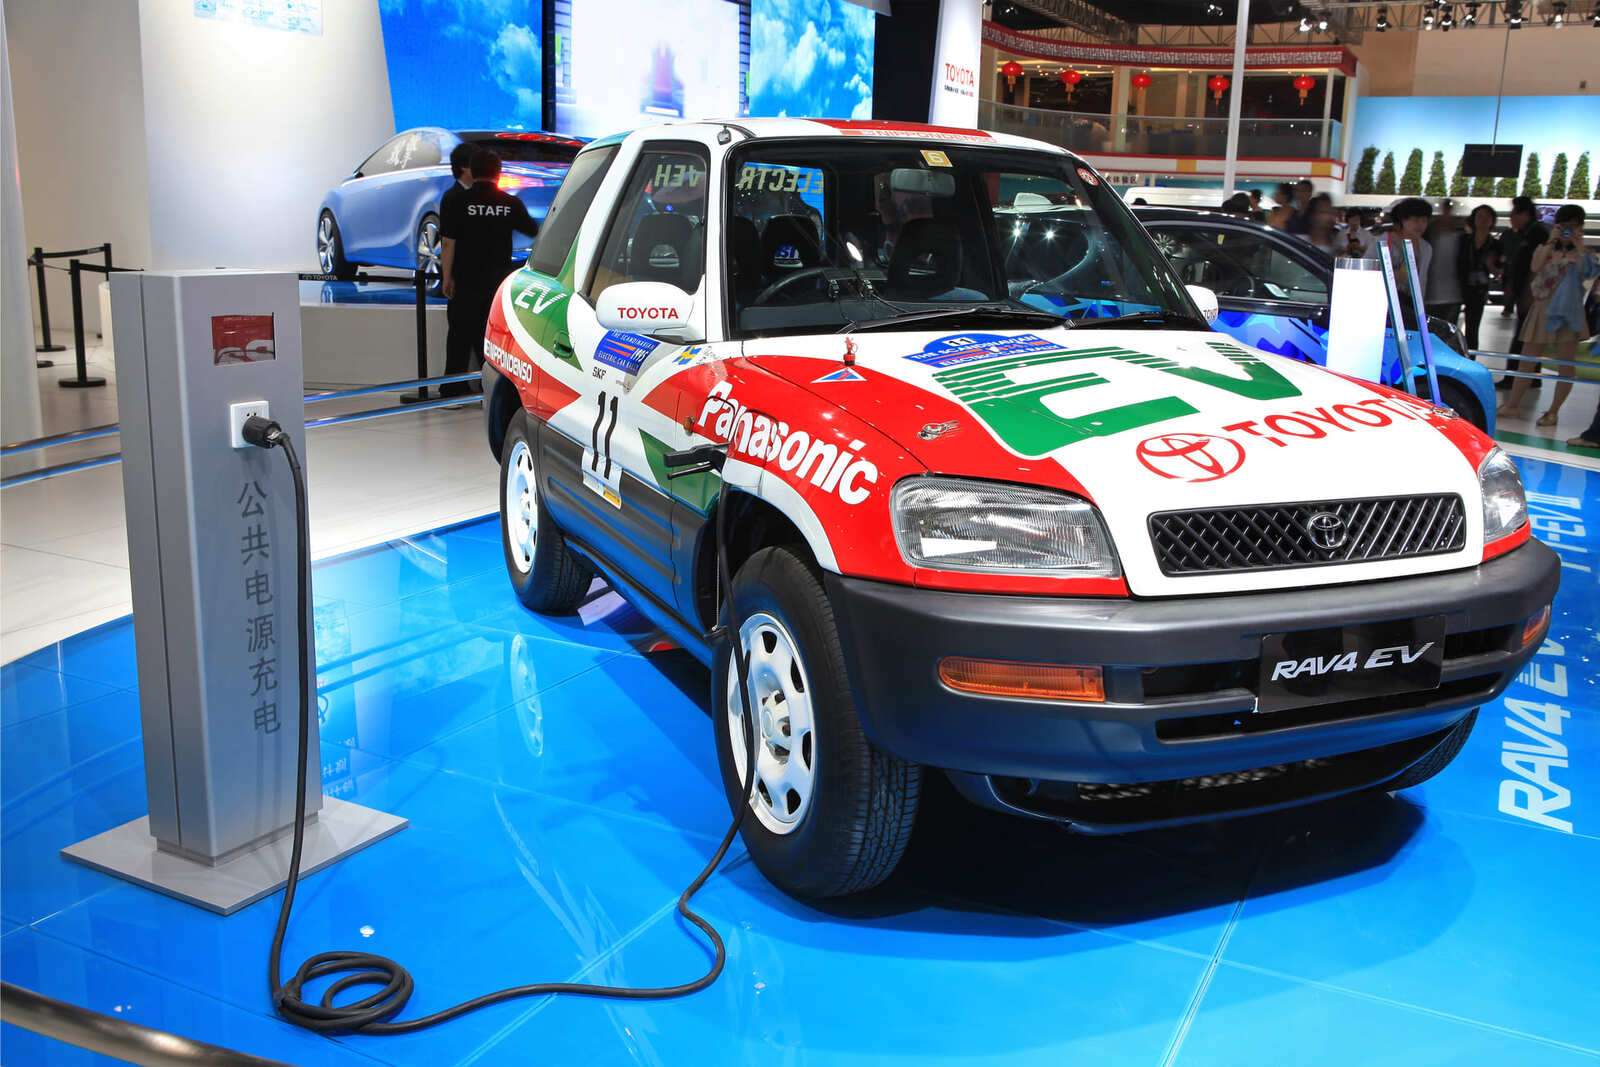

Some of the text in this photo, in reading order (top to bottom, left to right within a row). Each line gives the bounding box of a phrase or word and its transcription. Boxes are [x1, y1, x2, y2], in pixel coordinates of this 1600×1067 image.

[945, 62, 974, 87] TOYOTA
[467, 204, 512, 217] STAFF
[514, 281, 567, 315] EV
[617, 307, 679, 319] TOYOTA
[949, 338, 973, 346] 11
[593, 366, 607, 380] SKF
[932, 338, 1303, 457] EV
[590, 391, 618, 480] 11
[697, 380, 878, 505] Panasonic
[1221, 398, 1432, 448] TOYOTA
[237, 479, 281, 735] 公共电源充电
[1271, 641, 1435, 681] RAV4 EV
[1499, 697, 1573, 834] RAV4
